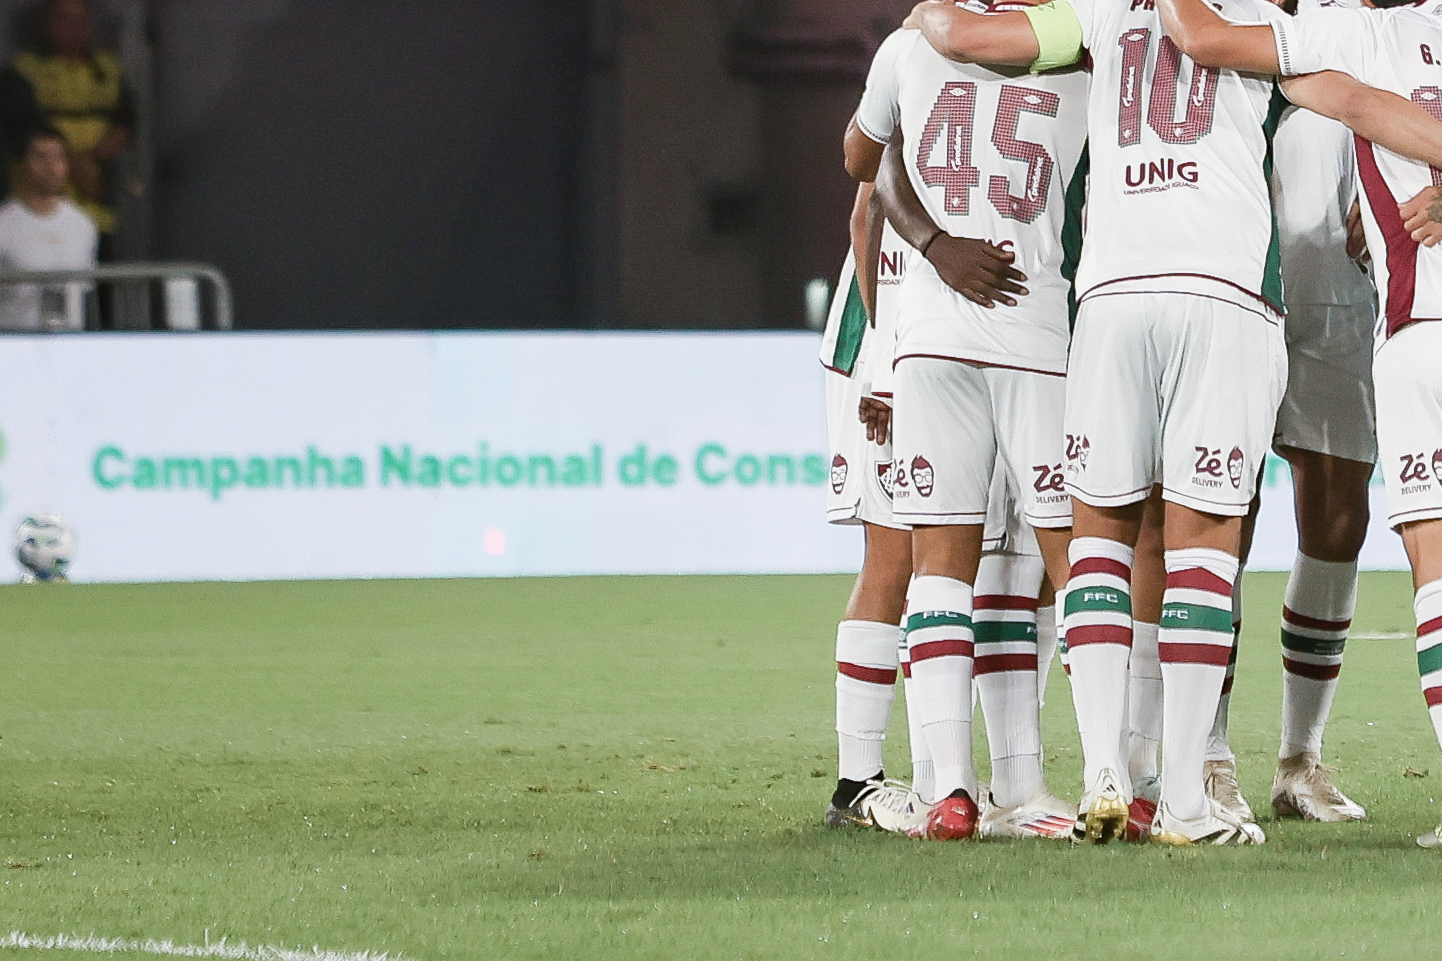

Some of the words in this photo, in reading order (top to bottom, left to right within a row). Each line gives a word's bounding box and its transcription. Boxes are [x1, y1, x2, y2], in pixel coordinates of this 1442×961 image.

[1420, 43, 1441, 66] G.
[916, 81, 1060, 226] 45
[1125, 158, 1198, 187] UNIG
[91, 445, 364, 500] Campanha
[381, 441, 601, 488] Nacional
[617, 441, 677, 487] de
[695, 442, 828, 487] Cons
[1195, 446, 1224, 477] Zé
[1399, 452, 1431, 485] Zé
[1032, 463, 1066, 493] Zé
[1192, 476, 1224, 489] DELIVERY
[1401, 483, 1432, 496] DELIVERY
[1036, 493, 1070, 504] DELIVERY
[1084, 592, 1118, 603] FFC
[923, 611, 958, 619] FFC
[1162, 609, 1189, 620] FFC
